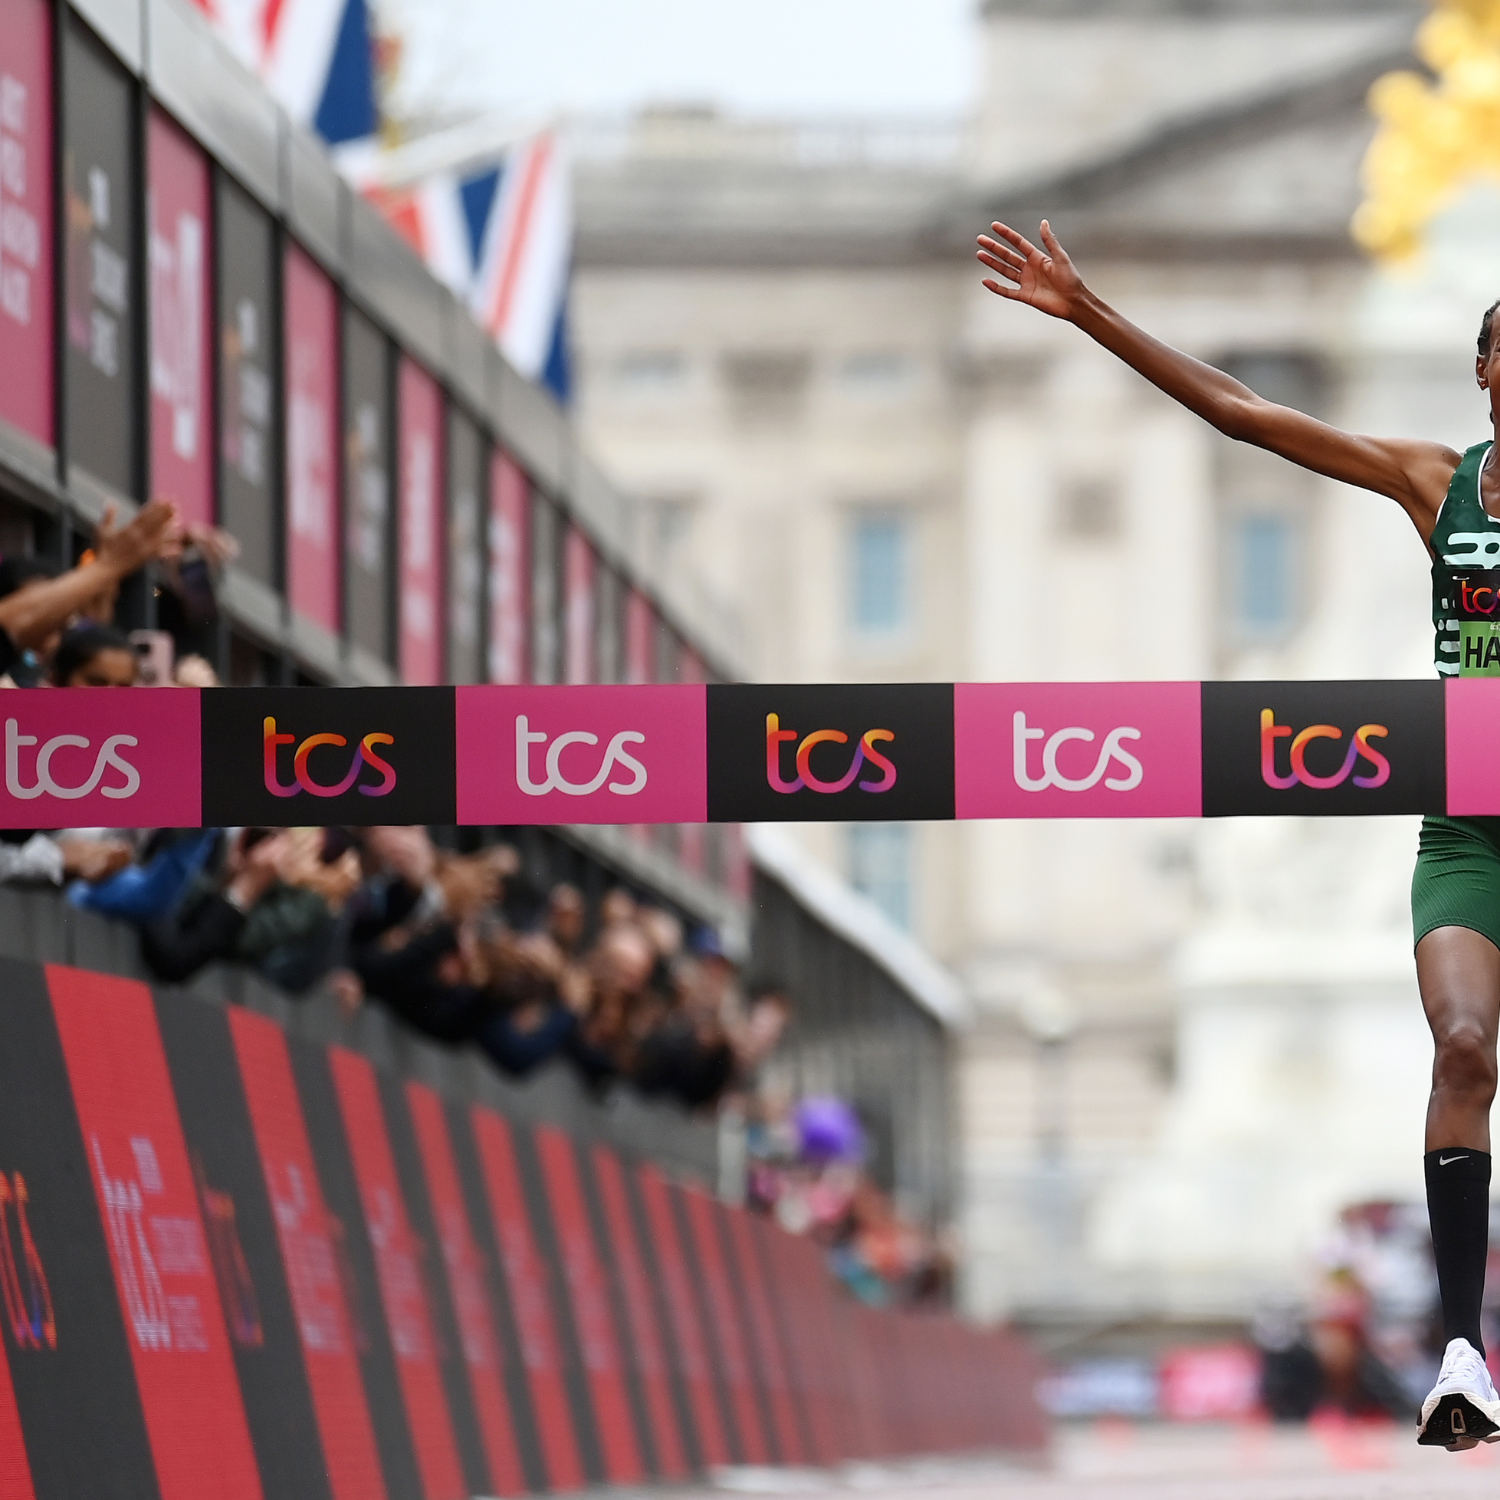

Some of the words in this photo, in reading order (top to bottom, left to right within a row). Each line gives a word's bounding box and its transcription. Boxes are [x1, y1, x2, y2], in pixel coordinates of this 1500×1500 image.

[5, 717, 141, 800] tcs
[264, 717, 396, 797] tcs
[517, 716, 646, 795] tcs
[766, 713, 897, 794] tcs
[1014, 712, 1143, 792] tcs
[1261, 708, 1390, 789] tcs
